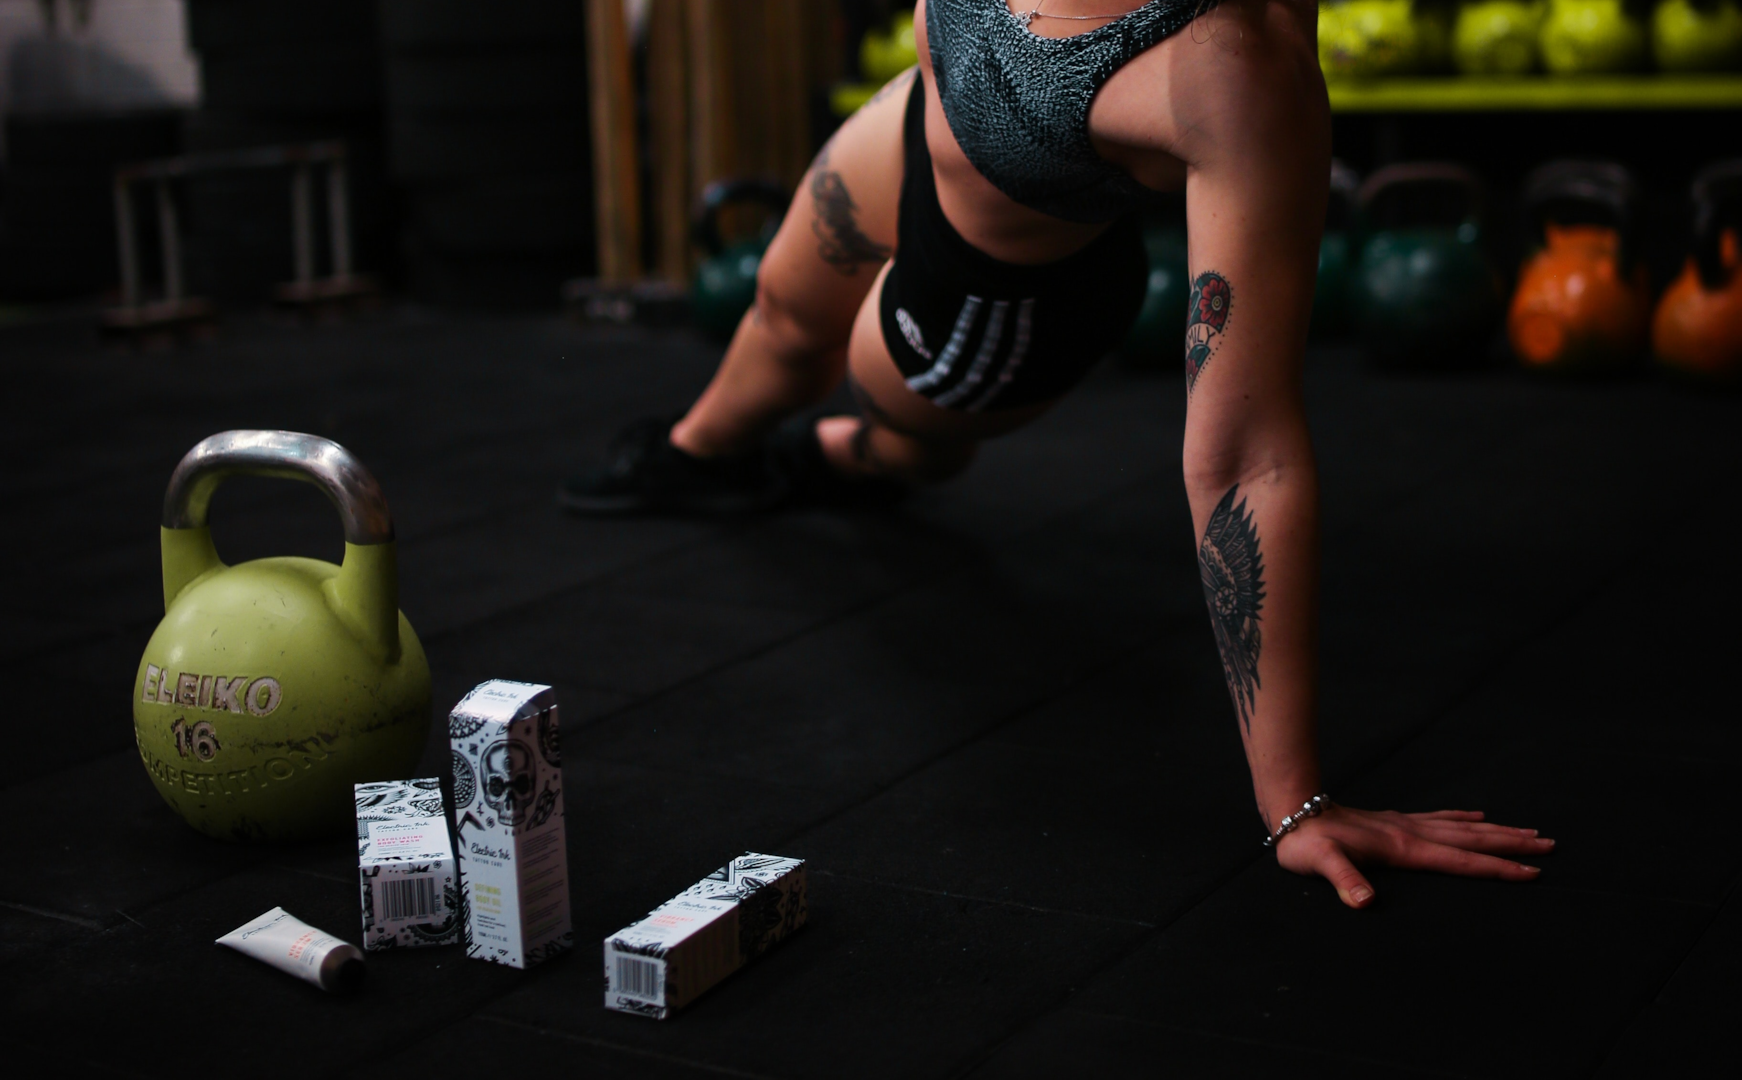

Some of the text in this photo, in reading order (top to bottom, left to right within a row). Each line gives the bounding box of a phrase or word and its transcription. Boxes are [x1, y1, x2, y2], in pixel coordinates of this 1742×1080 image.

[142, 663, 282, 717] ELEIKO
[171, 716, 221, 762] 16
[471, 842, 511, 861] Electric Ink
